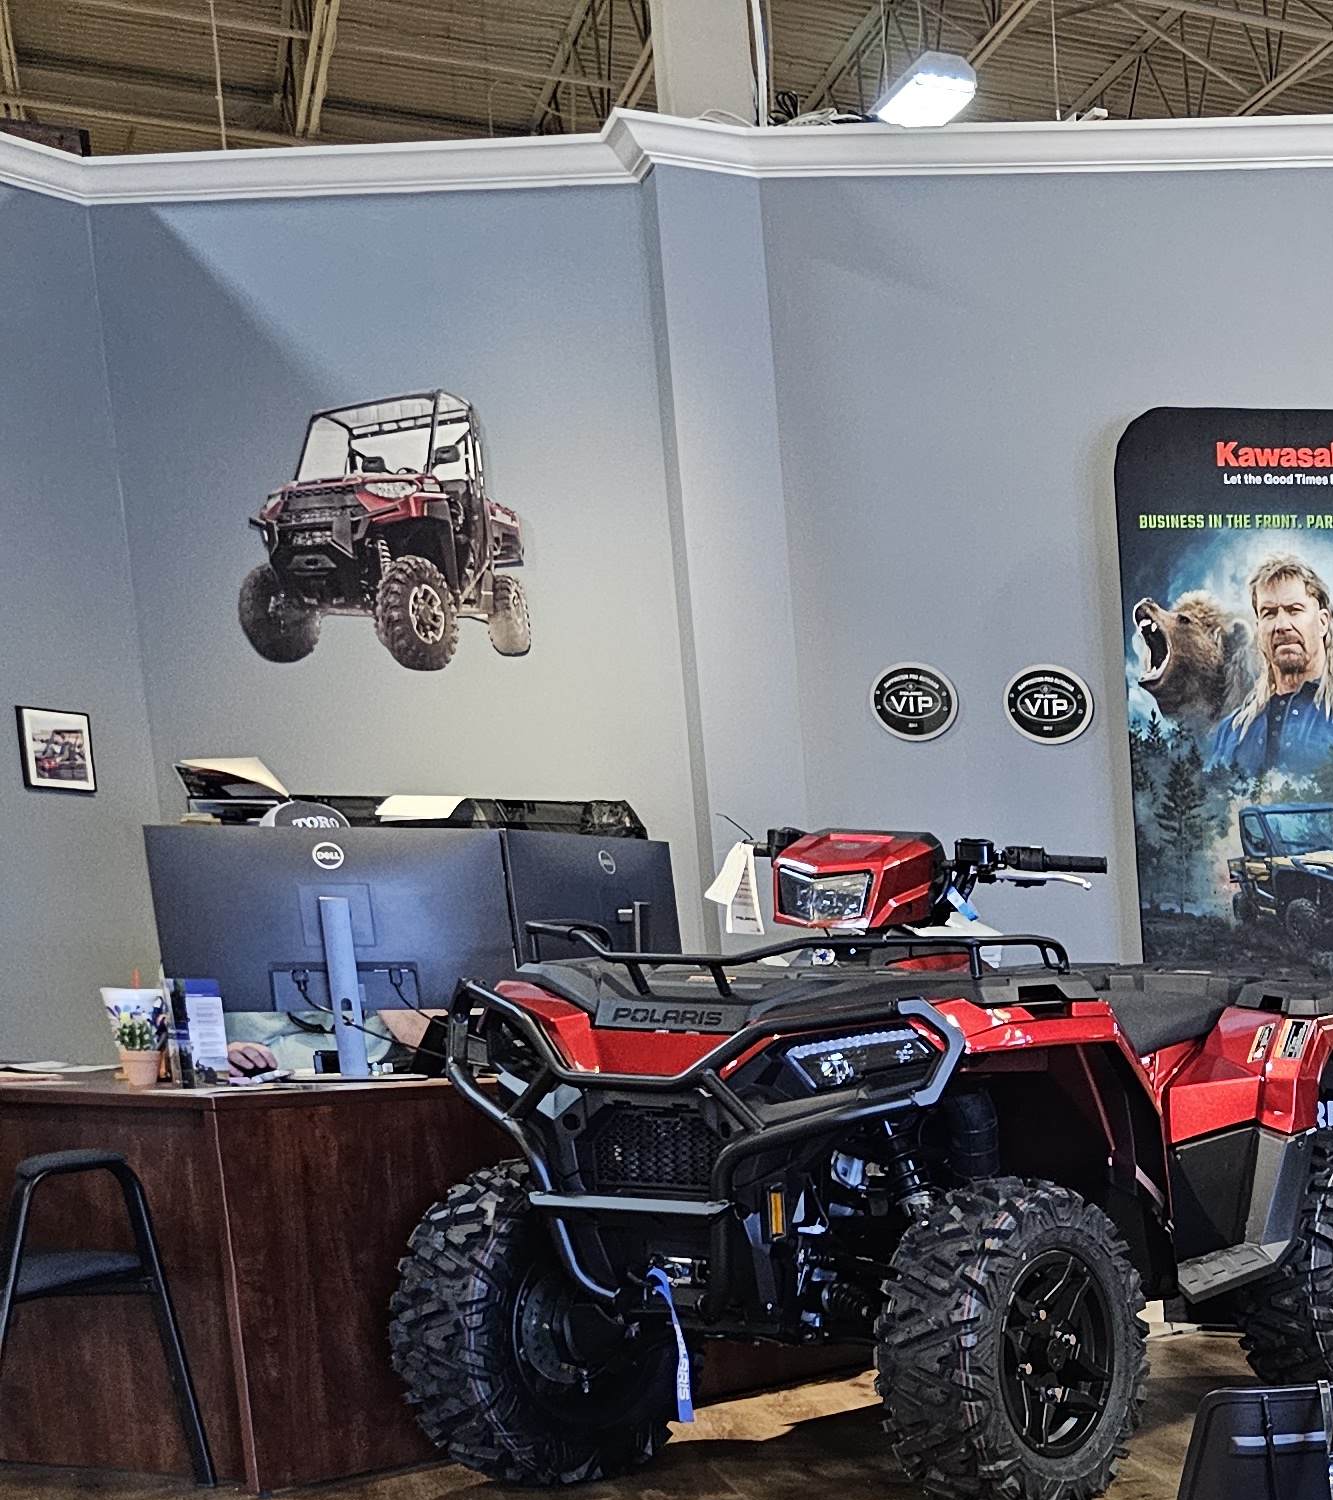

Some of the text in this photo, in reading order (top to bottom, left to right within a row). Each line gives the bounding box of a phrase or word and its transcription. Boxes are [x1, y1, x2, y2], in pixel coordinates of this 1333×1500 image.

[1223, 473, 1242, 485] Let
[1244, 473, 1262, 485] the
[1263, 473, 1293, 485] Good
[1295, 473, 1329, 485] Times
[1139, 514, 1205, 529] BUSINESS
[1208, 514, 1223, 529] IN
[1226, 514, 1251, 529] THE
[1255, 514, 1303, 530] FRONT.
[890, 696, 933, 714] VIP
[1024, 698, 1069, 716] VIP
[316, 851, 341, 861] DELL
[612, 1007, 723, 1026] POLARIS
